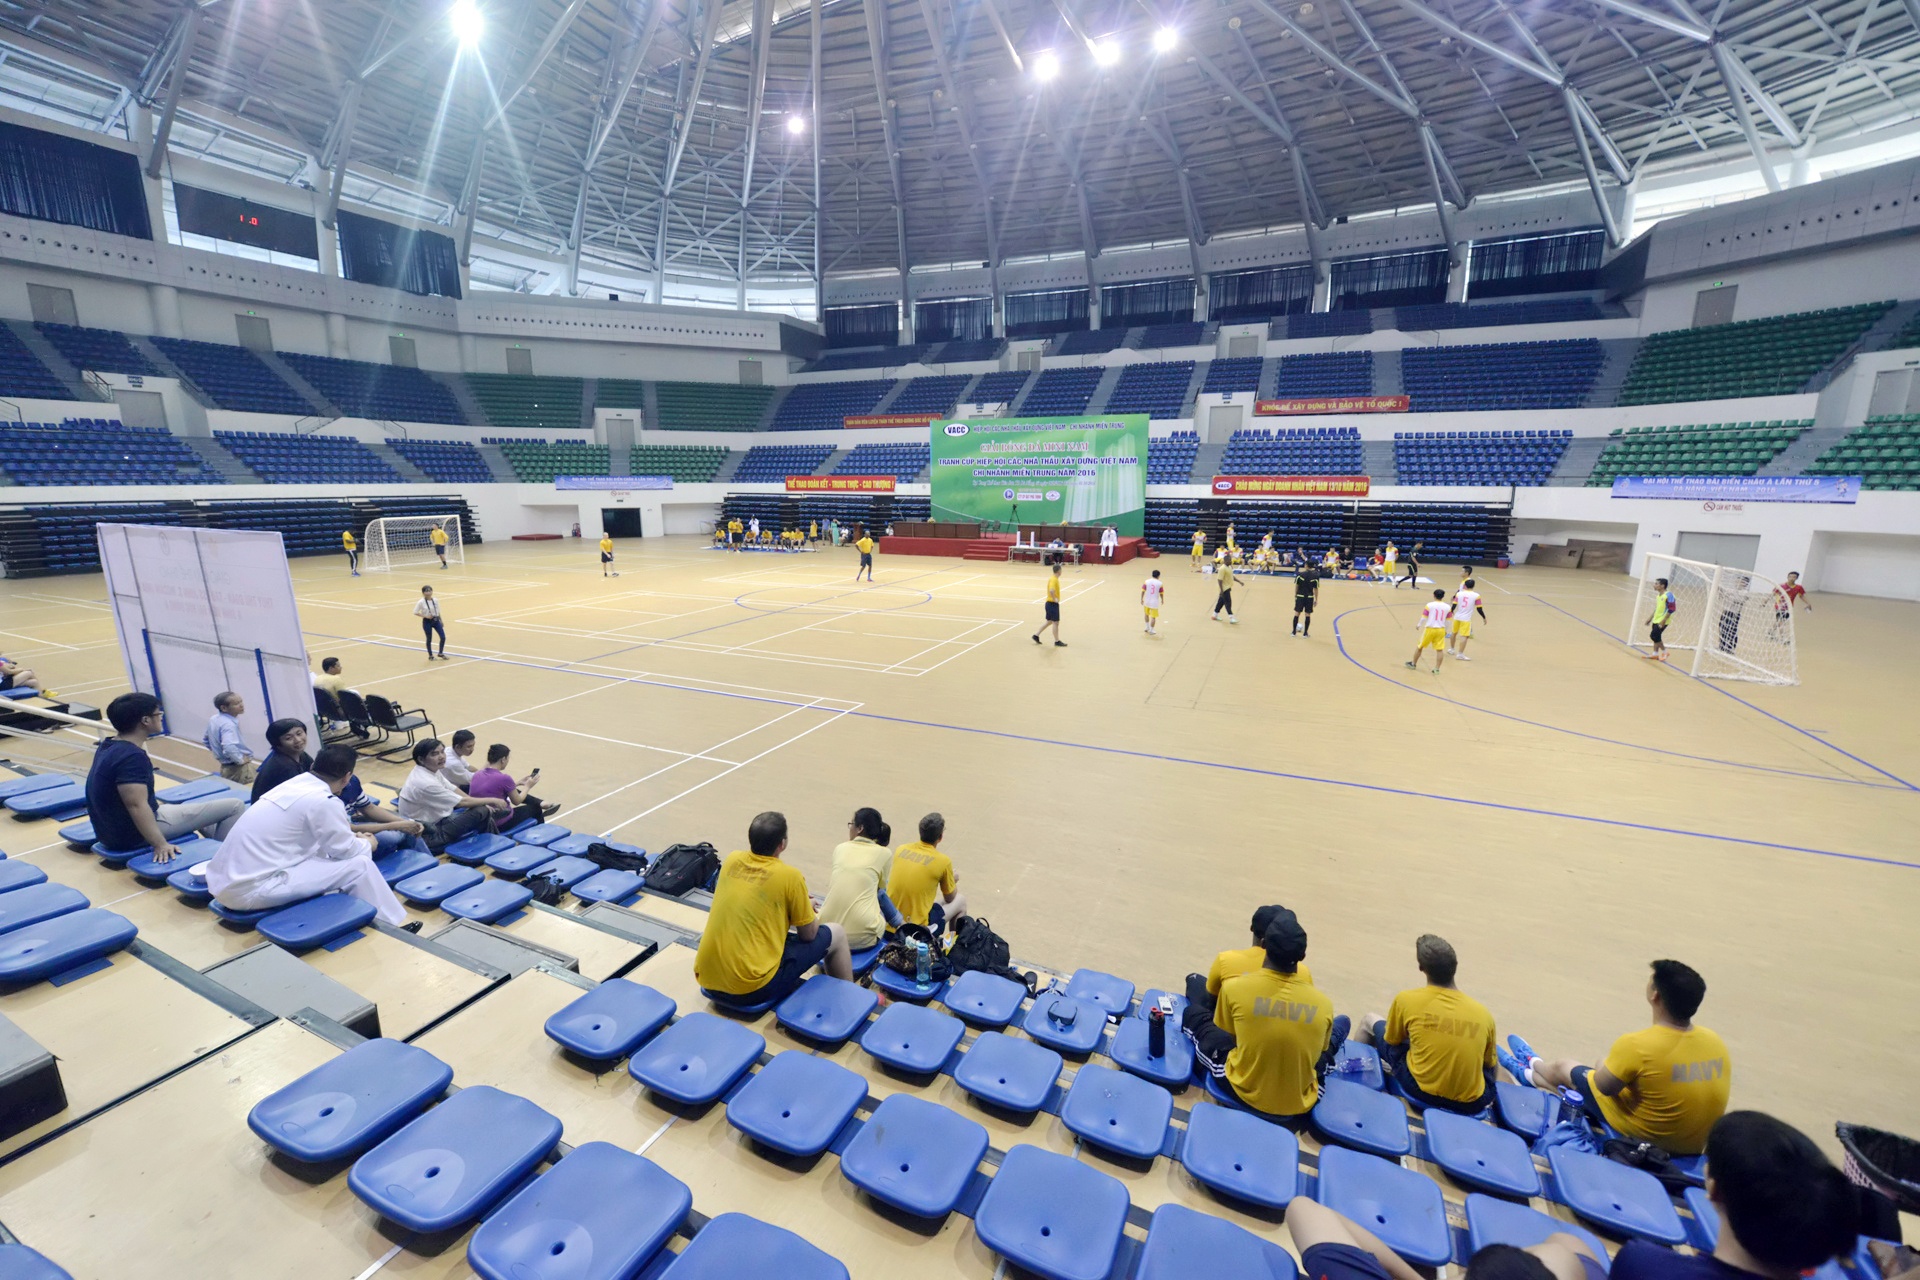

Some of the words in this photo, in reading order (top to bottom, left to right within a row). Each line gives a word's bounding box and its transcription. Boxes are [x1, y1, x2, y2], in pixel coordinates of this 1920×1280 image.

[947, 426, 966, 434] VACC
[1043, 442, 1065, 451] MINI
[1067, 442, 1089, 451] NAM
[962, 457, 975, 465] CÚP
[994, 457, 1006, 467] HỘI
[1008, 457, 1022, 465] CÁC
[1061, 456, 1076, 465] XÂY
[1077, 457, 1098, 466] DỰNG
[1100, 456, 1117, 466] VIỆT
[973, 469, 985, 477] CHI
[986, 468, 1010, 477] NHÁNH
[1150, 584, 1156, 595] 3
[1461, 596, 1469, 608] 5
[1434, 608, 1445, 621] 11
[898, 848, 936, 866] NAVY
[1252, 996, 1318, 1024] NAVY
[1423, 1012, 1480, 1040] NAVY
[1670, 1057, 1724, 1083] NAVY
